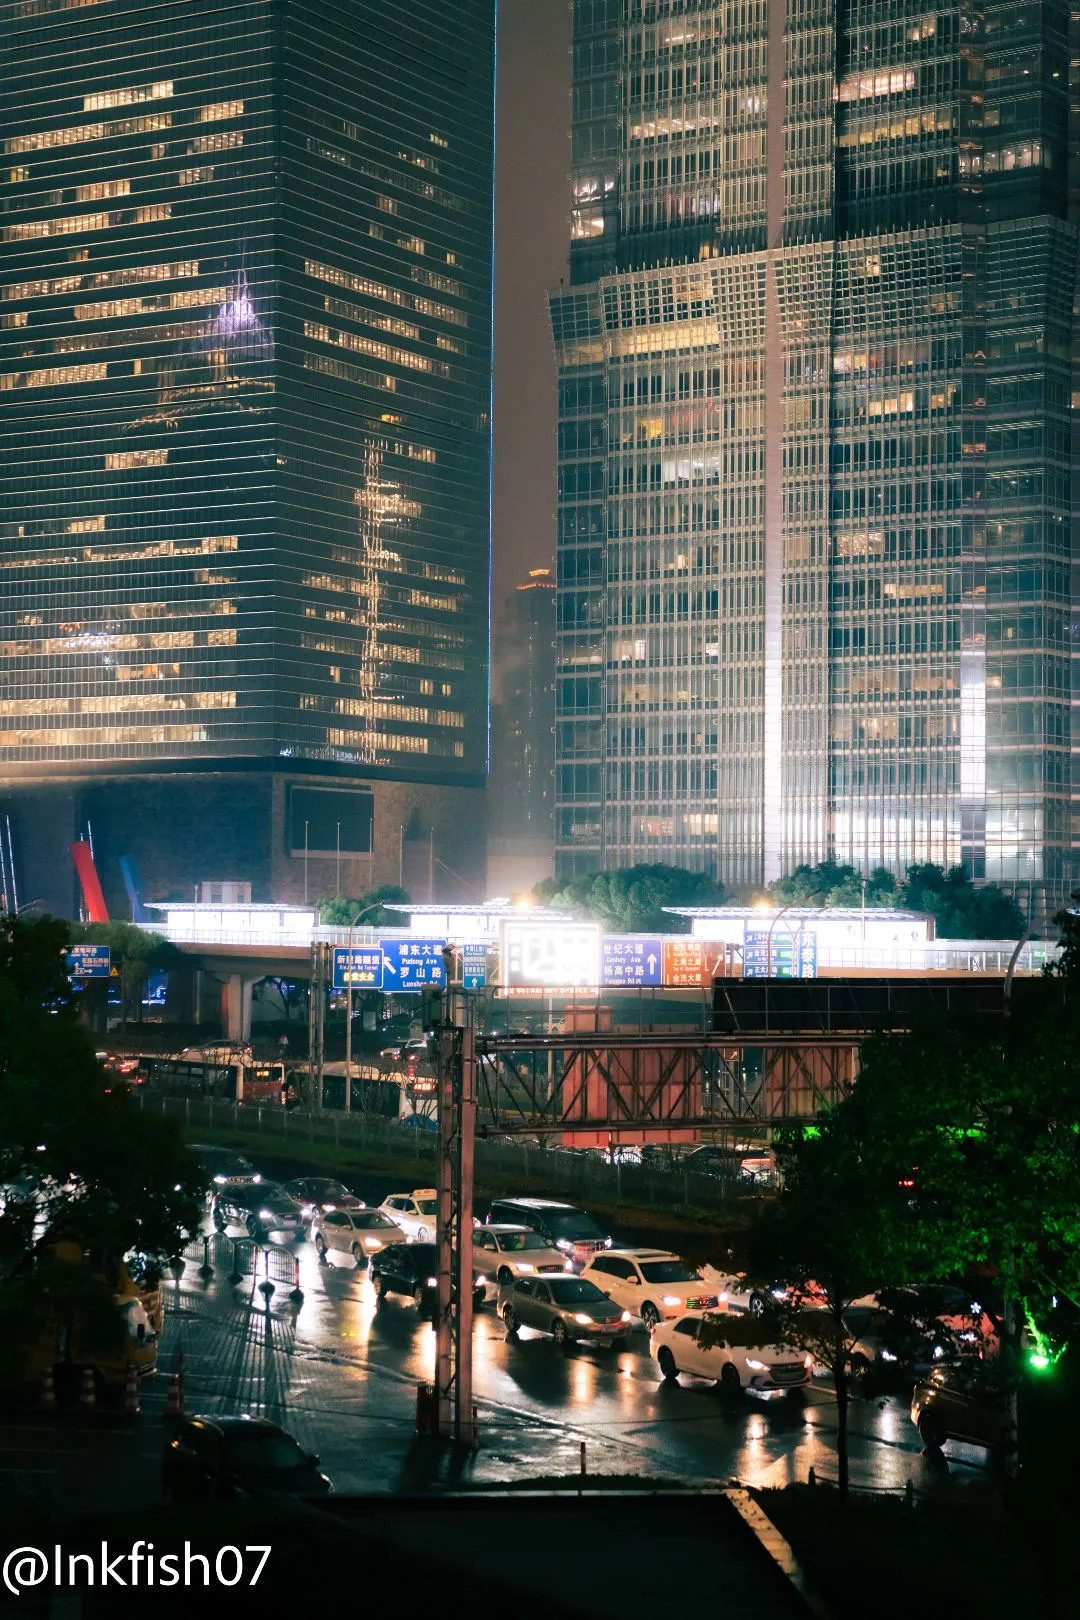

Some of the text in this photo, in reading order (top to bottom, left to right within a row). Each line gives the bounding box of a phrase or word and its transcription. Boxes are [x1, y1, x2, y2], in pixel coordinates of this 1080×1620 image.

[399, 944, 443, 956] 浦东大道
[604, 943, 644, 955] 世纪大道
[802, 932, 815, 978] 东泰路
[402, 957, 437, 966] Pudong Ave
[400, 967, 442, 978] 罗山路
[604, 965, 645, 977] 杨高中路
[673, 973, 702, 983] 金茂大厦
